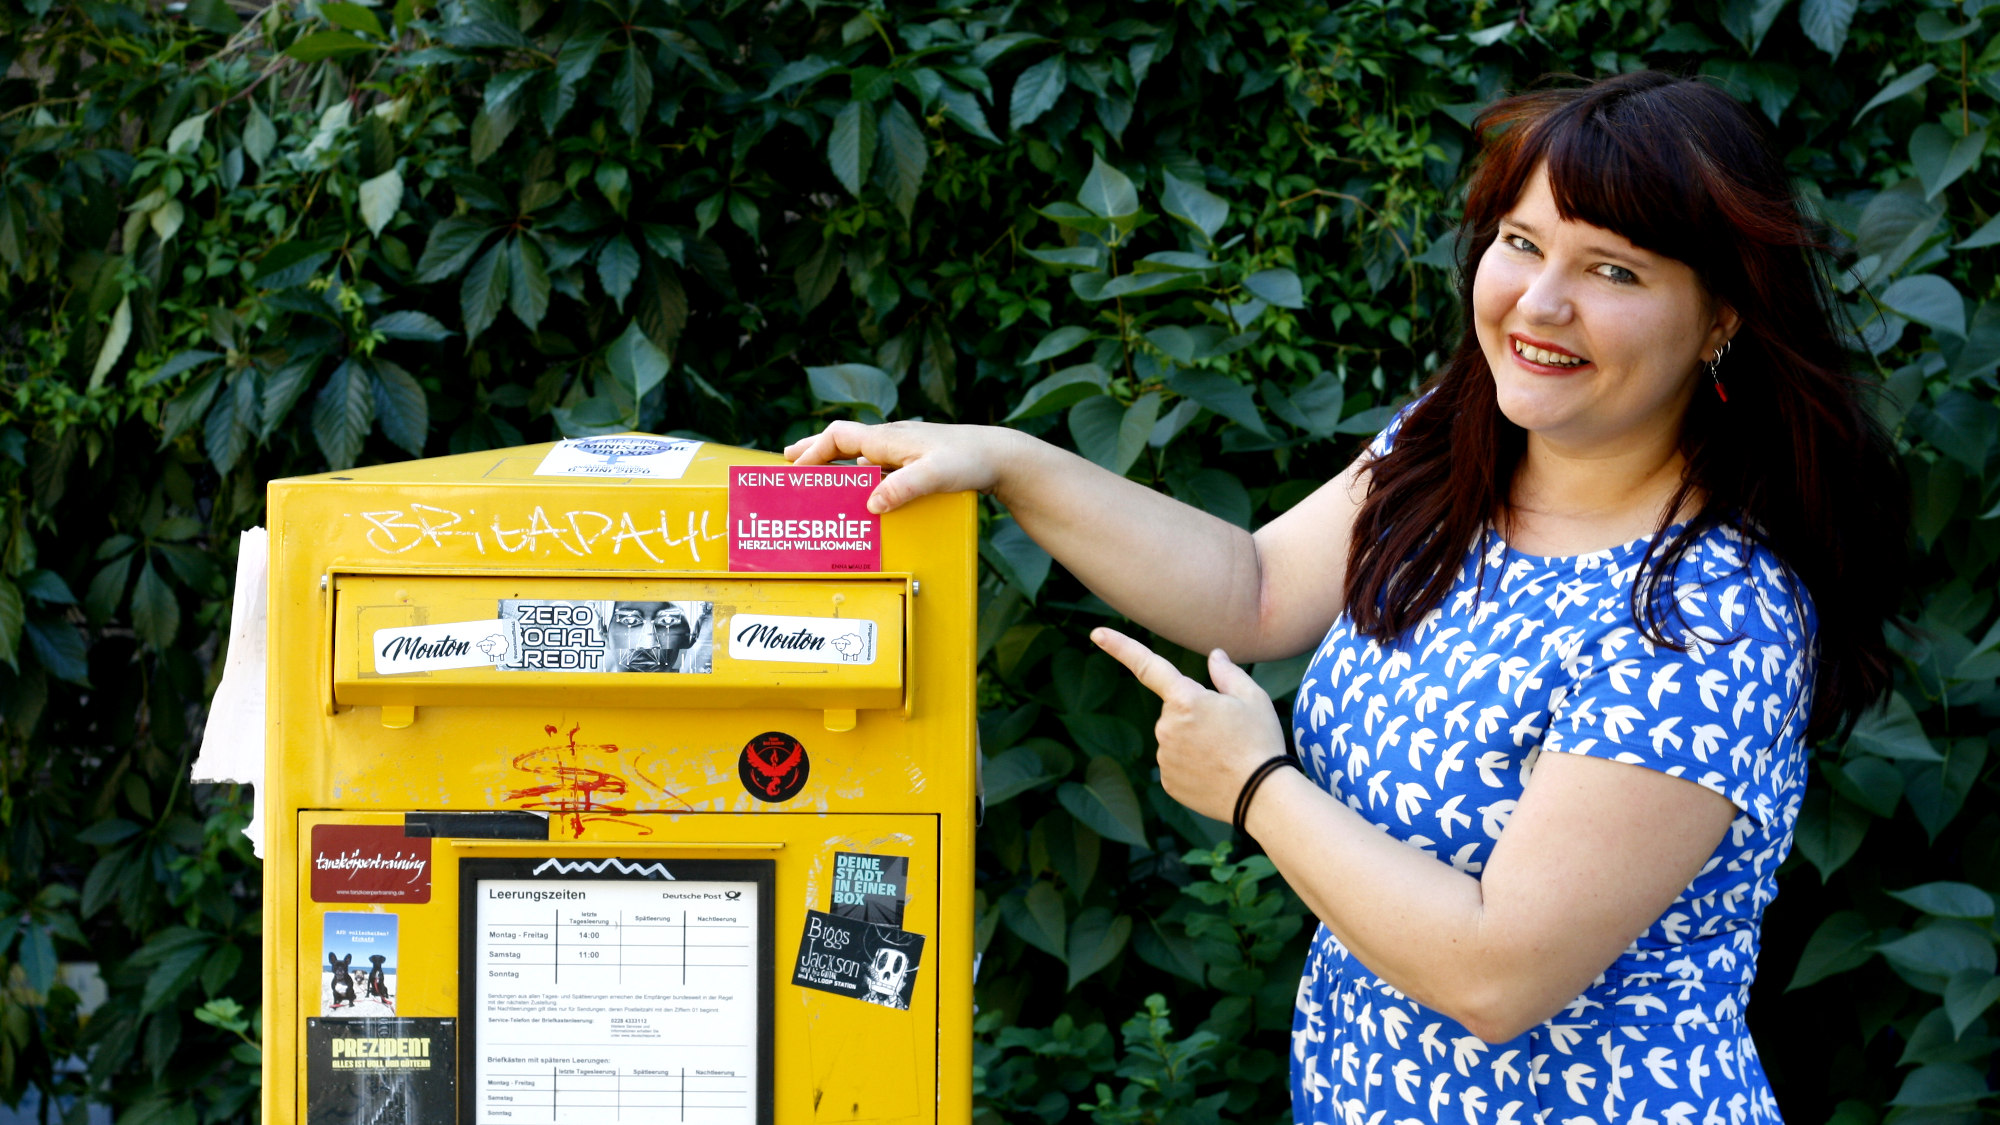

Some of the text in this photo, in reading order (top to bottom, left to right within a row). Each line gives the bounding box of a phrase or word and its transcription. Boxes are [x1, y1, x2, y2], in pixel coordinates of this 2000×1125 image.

[563, 443, 690, 453] FEMINISTISCHE
[738, 473, 872, 488] KEINE WERBUNG!
[738, 540, 871, 550] HERZLICH WILLKOMMEN
[518, 605, 593, 625] ZERO
[736, 623, 826, 651] Mouton
[382, 635, 471, 662] Mouton
[315, 849, 427, 884] tanzkörpertraining
[836, 855, 881, 870] DEINE
[835, 867, 885, 883] STADT
[835, 879, 897, 897] IN EINER
[489, 888, 586, 903] Leerungszeiten
[662, 892, 702, 900] Deutsche
[833, 891, 865, 906] BOX
[569, 918, 610, 926] Tagesleerung
[634, 915, 671, 924] Spätleerung
[697, 916, 737, 924] Nachtleerung
[489, 931, 517, 940] Montag
[523, 931, 549, 941] Freitag
[579, 931, 600, 939] 14:00
[807, 916, 851, 950] Biggs
[489, 951, 521, 960] Samstag
[579, 951, 600, 959] 11:00
[801, 938, 860, 978] Jackson
[489, 970, 520, 979] Sonntag
[818, 977, 833, 985] LOOP
[834, 979, 857, 990] STATION
[332, 1037, 431, 1058] PREZIDENT
[332, 1060, 354, 1069] ALLES
[354, 1060, 366, 1069] IST
[487, 1056, 526, 1064] Briefkästen
[540, 1057, 570, 1066] späteren
[572, 1057, 611, 1066] Leerungen:
[576, 1069, 617, 1077] Tagesleerung
[695, 1069, 735, 1077] Nachtleerung
[488, 1079, 510, 1087] Montag
[514, 1079, 535, 1087] Freitag
[488, 1094, 513, 1102] Samstag
[488, 1110, 512, 1118] Sonntag
